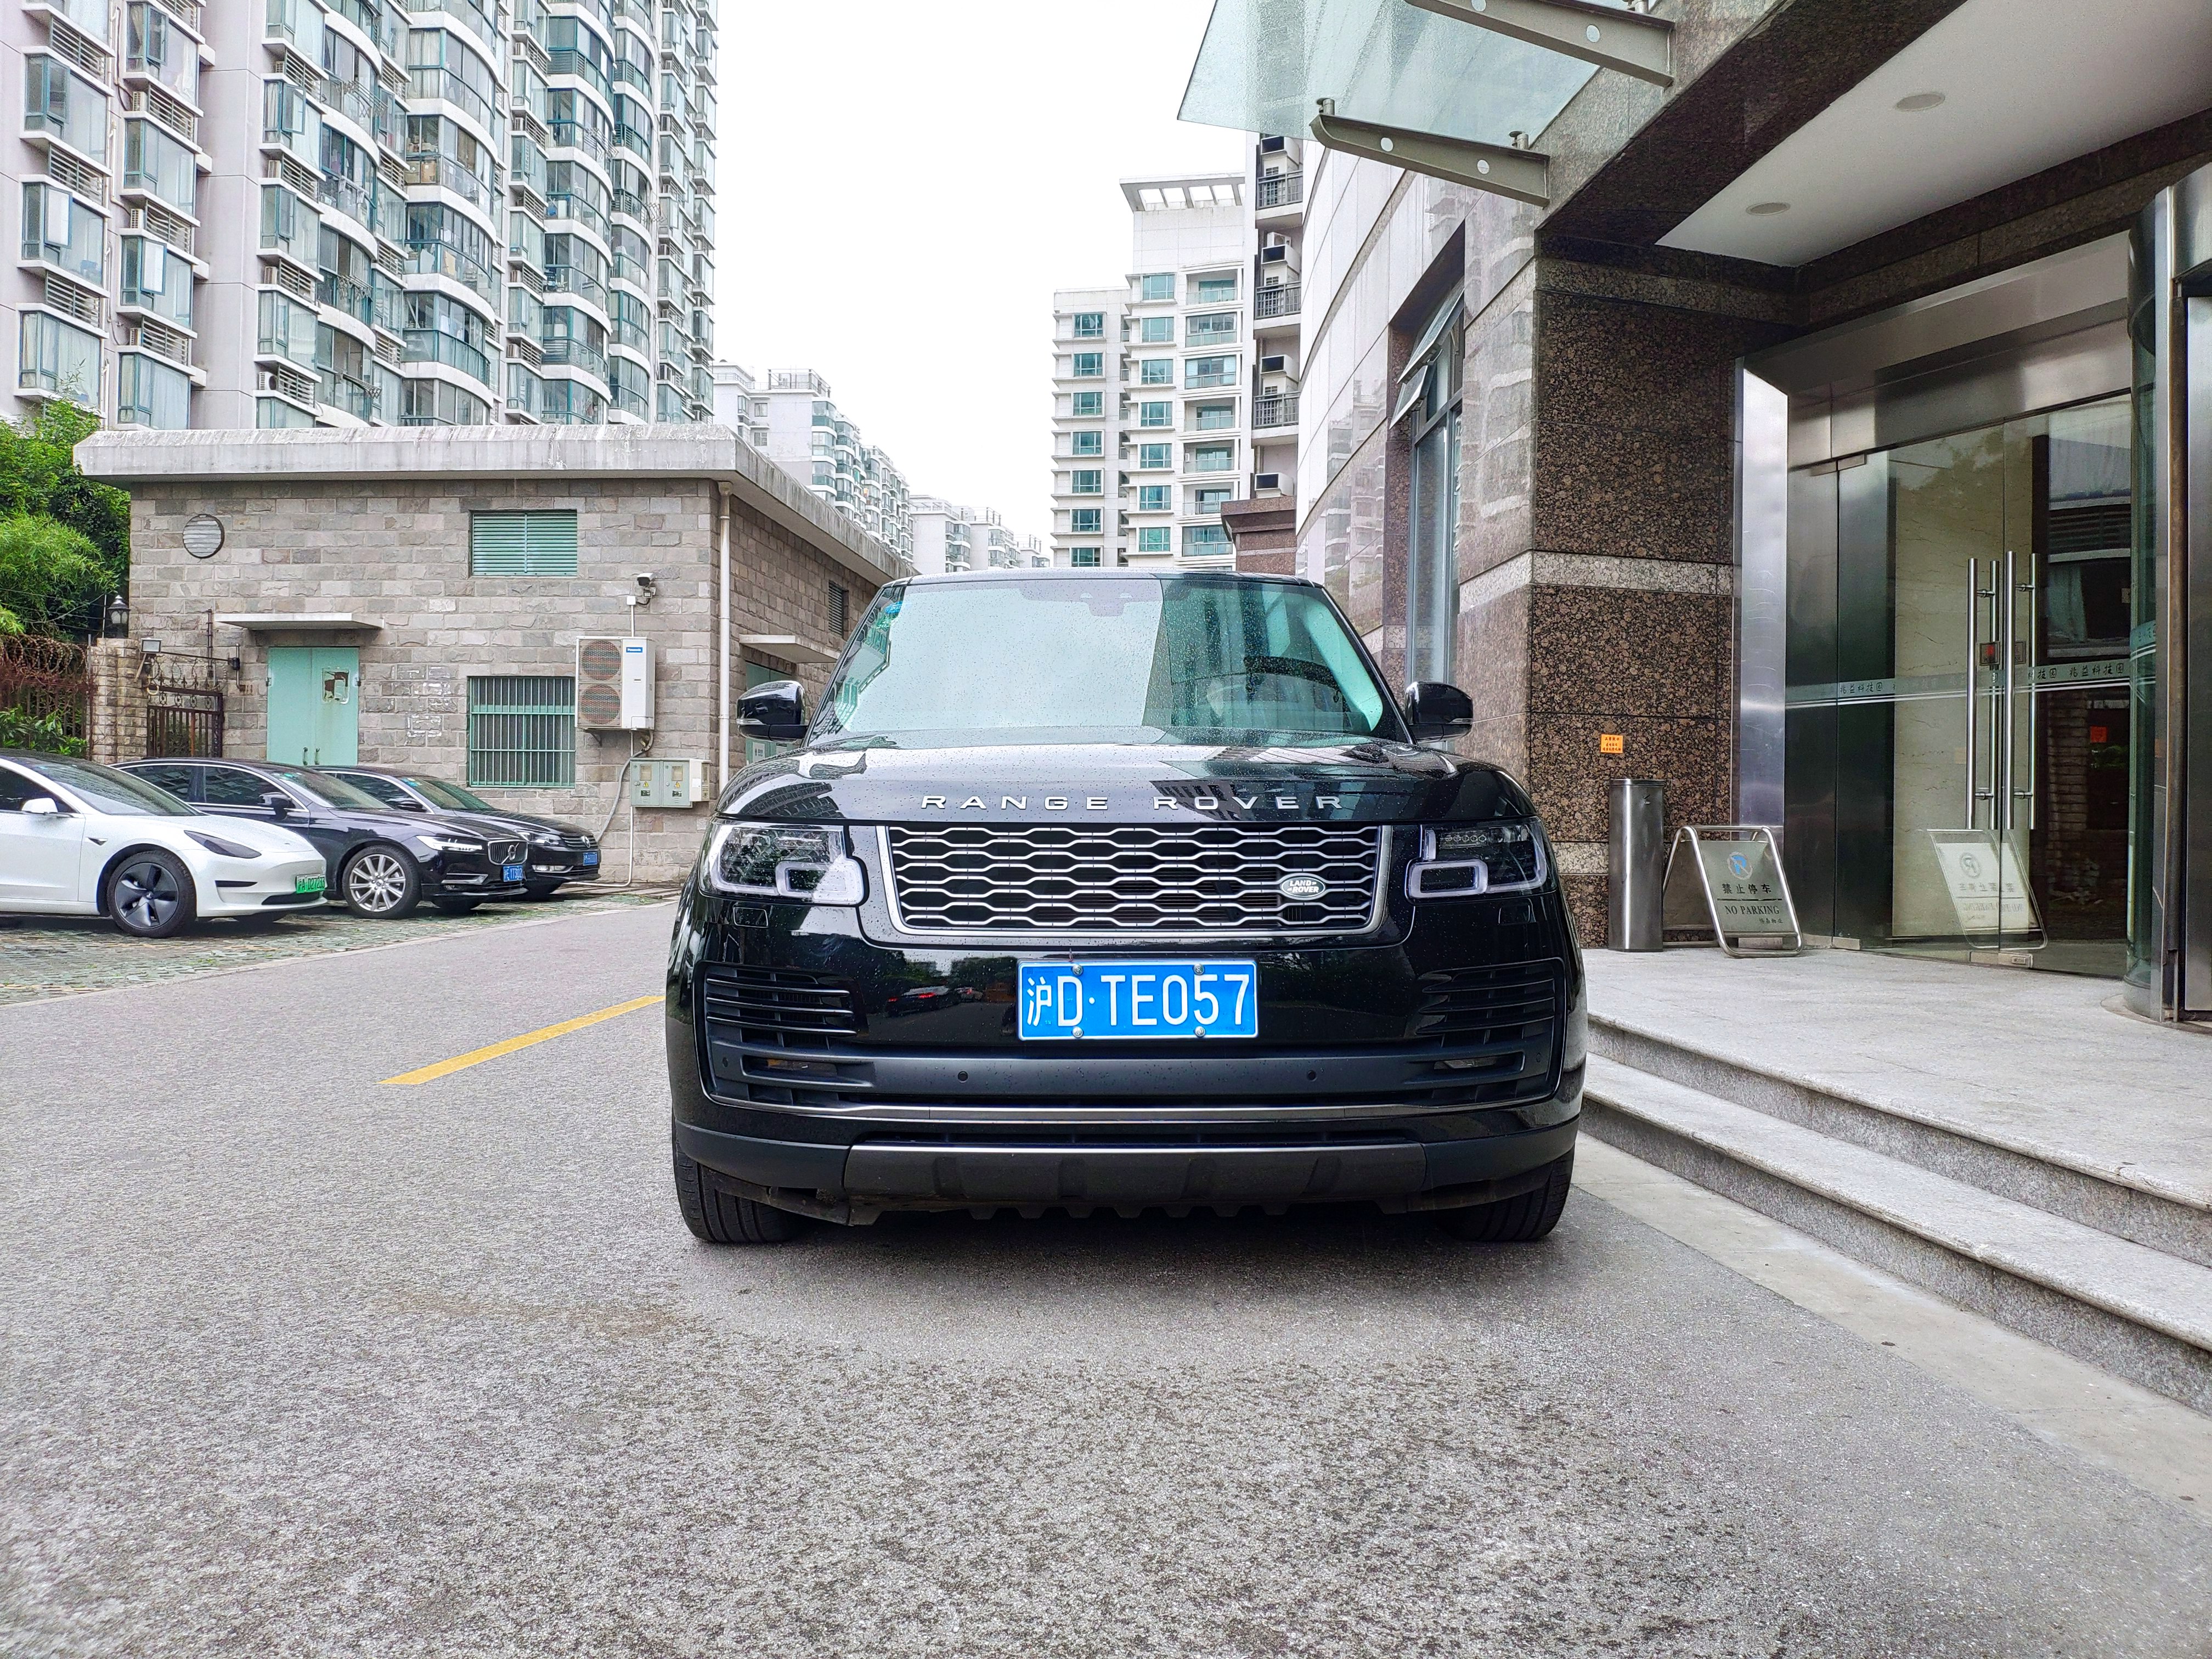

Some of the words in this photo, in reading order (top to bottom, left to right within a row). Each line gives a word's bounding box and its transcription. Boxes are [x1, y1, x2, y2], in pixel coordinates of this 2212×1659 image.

[921, 795, 1108, 810] RANGE
[1153, 795, 1342, 810] ROVER
[1722, 883, 1771, 894] 禁止停车
[1724, 905, 1737, 915] NO
[1740, 905, 1780, 915] PARKING
[1027, 974, 1250, 1026] 沪D·TE057
